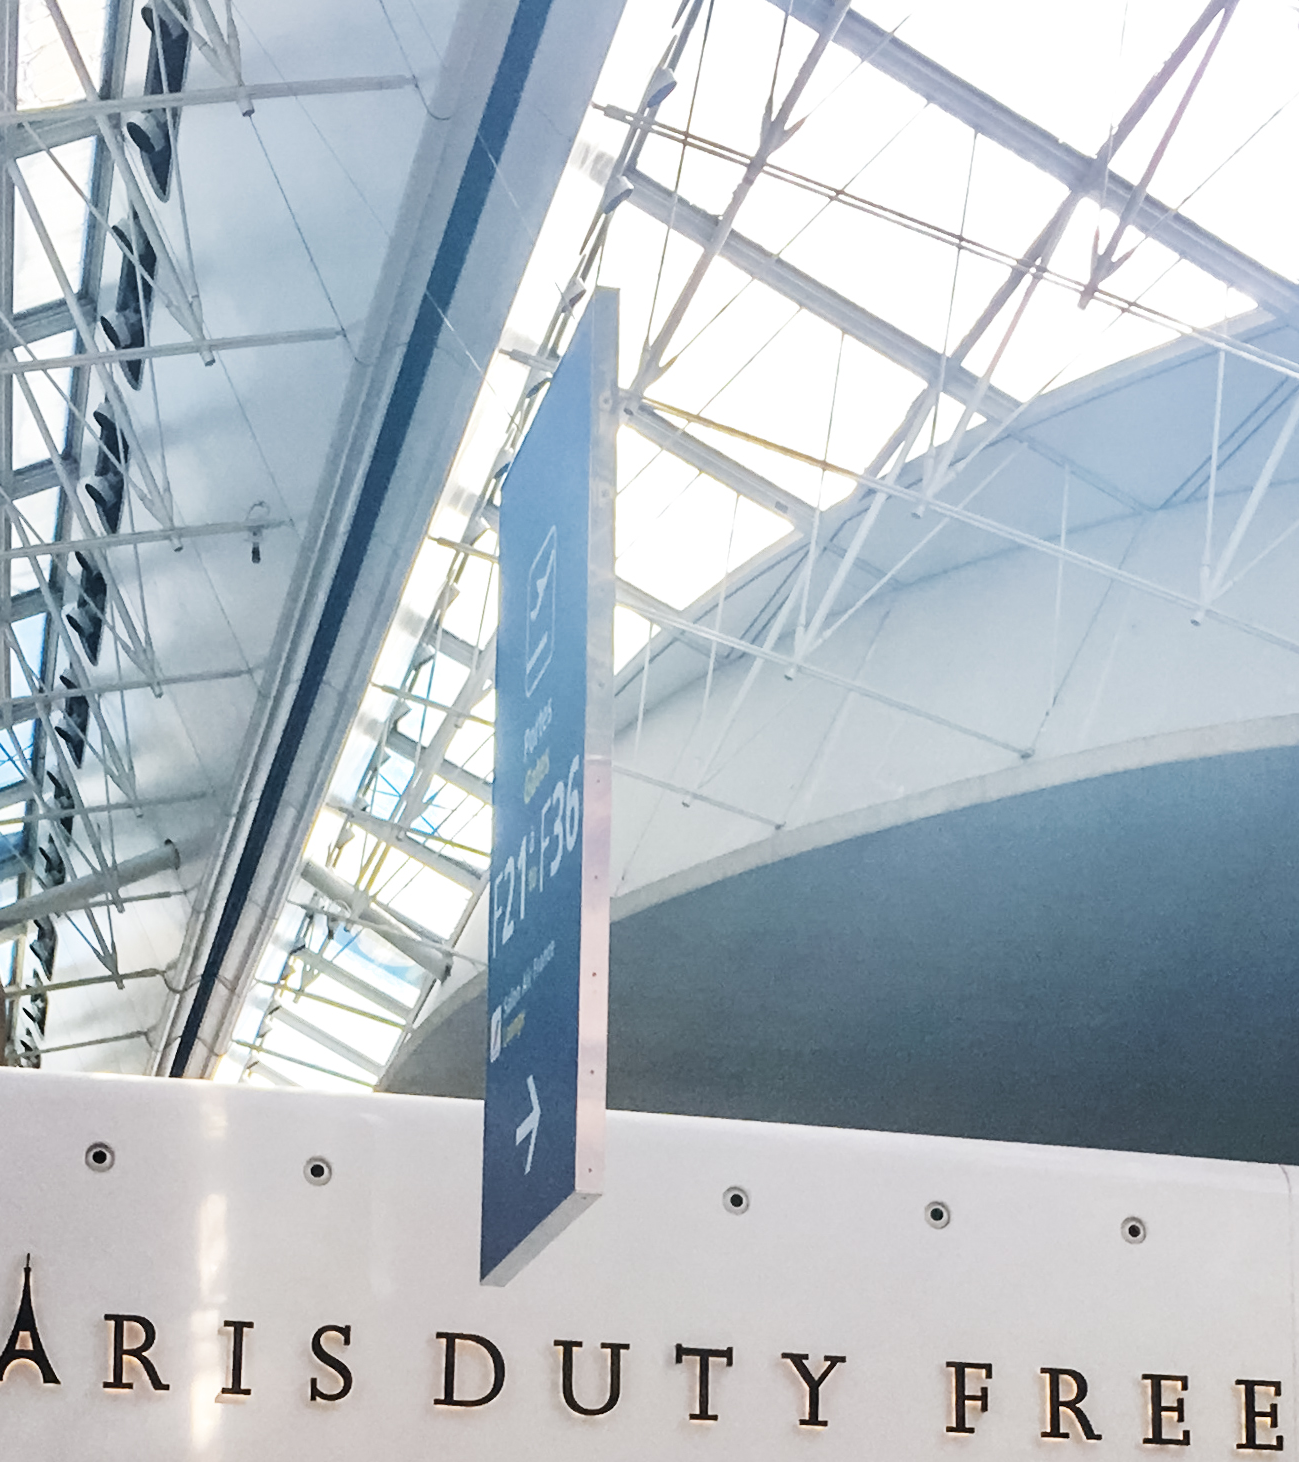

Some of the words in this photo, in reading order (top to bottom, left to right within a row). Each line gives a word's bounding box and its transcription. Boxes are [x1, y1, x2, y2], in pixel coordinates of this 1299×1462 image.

[493, 835, 527, 958] F21
[539, 754, 580, 893] F36
[433, 1331, 847, 1427] DUTY
[945, 1361, 1285, 1451] FREE
